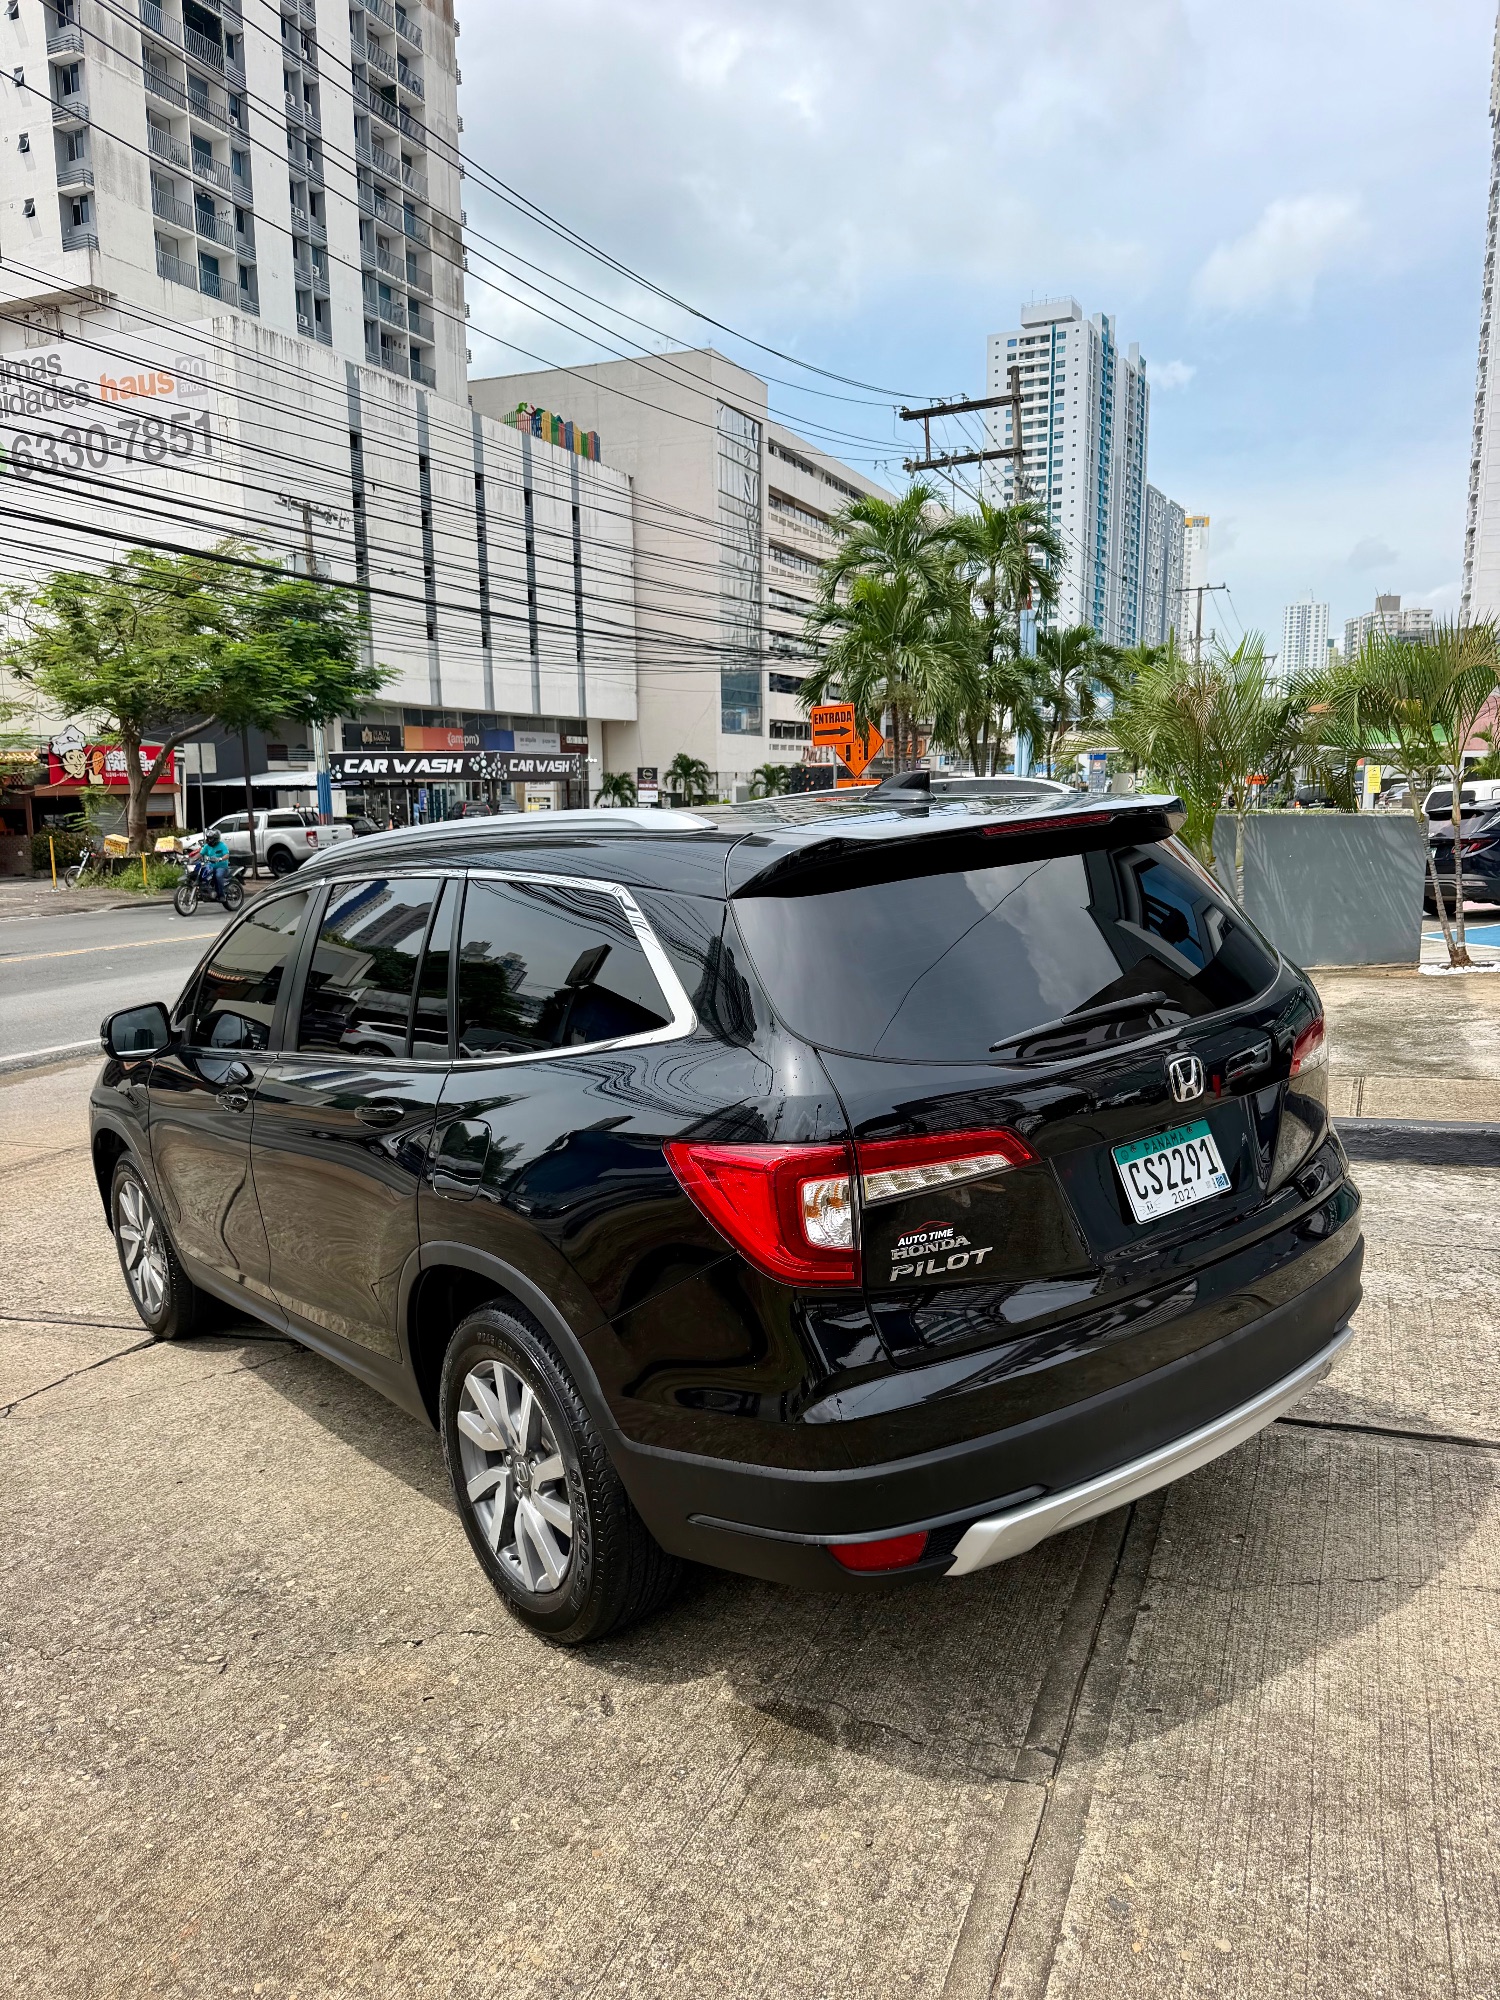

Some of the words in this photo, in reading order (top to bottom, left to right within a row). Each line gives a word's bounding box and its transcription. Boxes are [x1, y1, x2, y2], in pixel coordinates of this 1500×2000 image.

[0, 379, 90, 418] idades
[100, 372, 175, 401] haus
[11, 409, 213, 478] 6330-7851
[814, 711, 852, 724] ENTRADA
[344, 759, 389, 773] CAR
[393, 758, 464, 773] WASH
[509, 759, 534, 772] CAR
[536, 760, 570, 772] WASH
[1143, 1131, 1186, 1154] PANAMA
[1128, 1138, 1219, 1200] CS2291
[1171, 1186, 1197, 1205] 2021
[890, 1235, 972, 1260] HONDA
[898, 1234, 927, 1246] AUTO
[929, 1228, 954, 1240] TIME
[889, 1246, 993, 1282] PILOT
